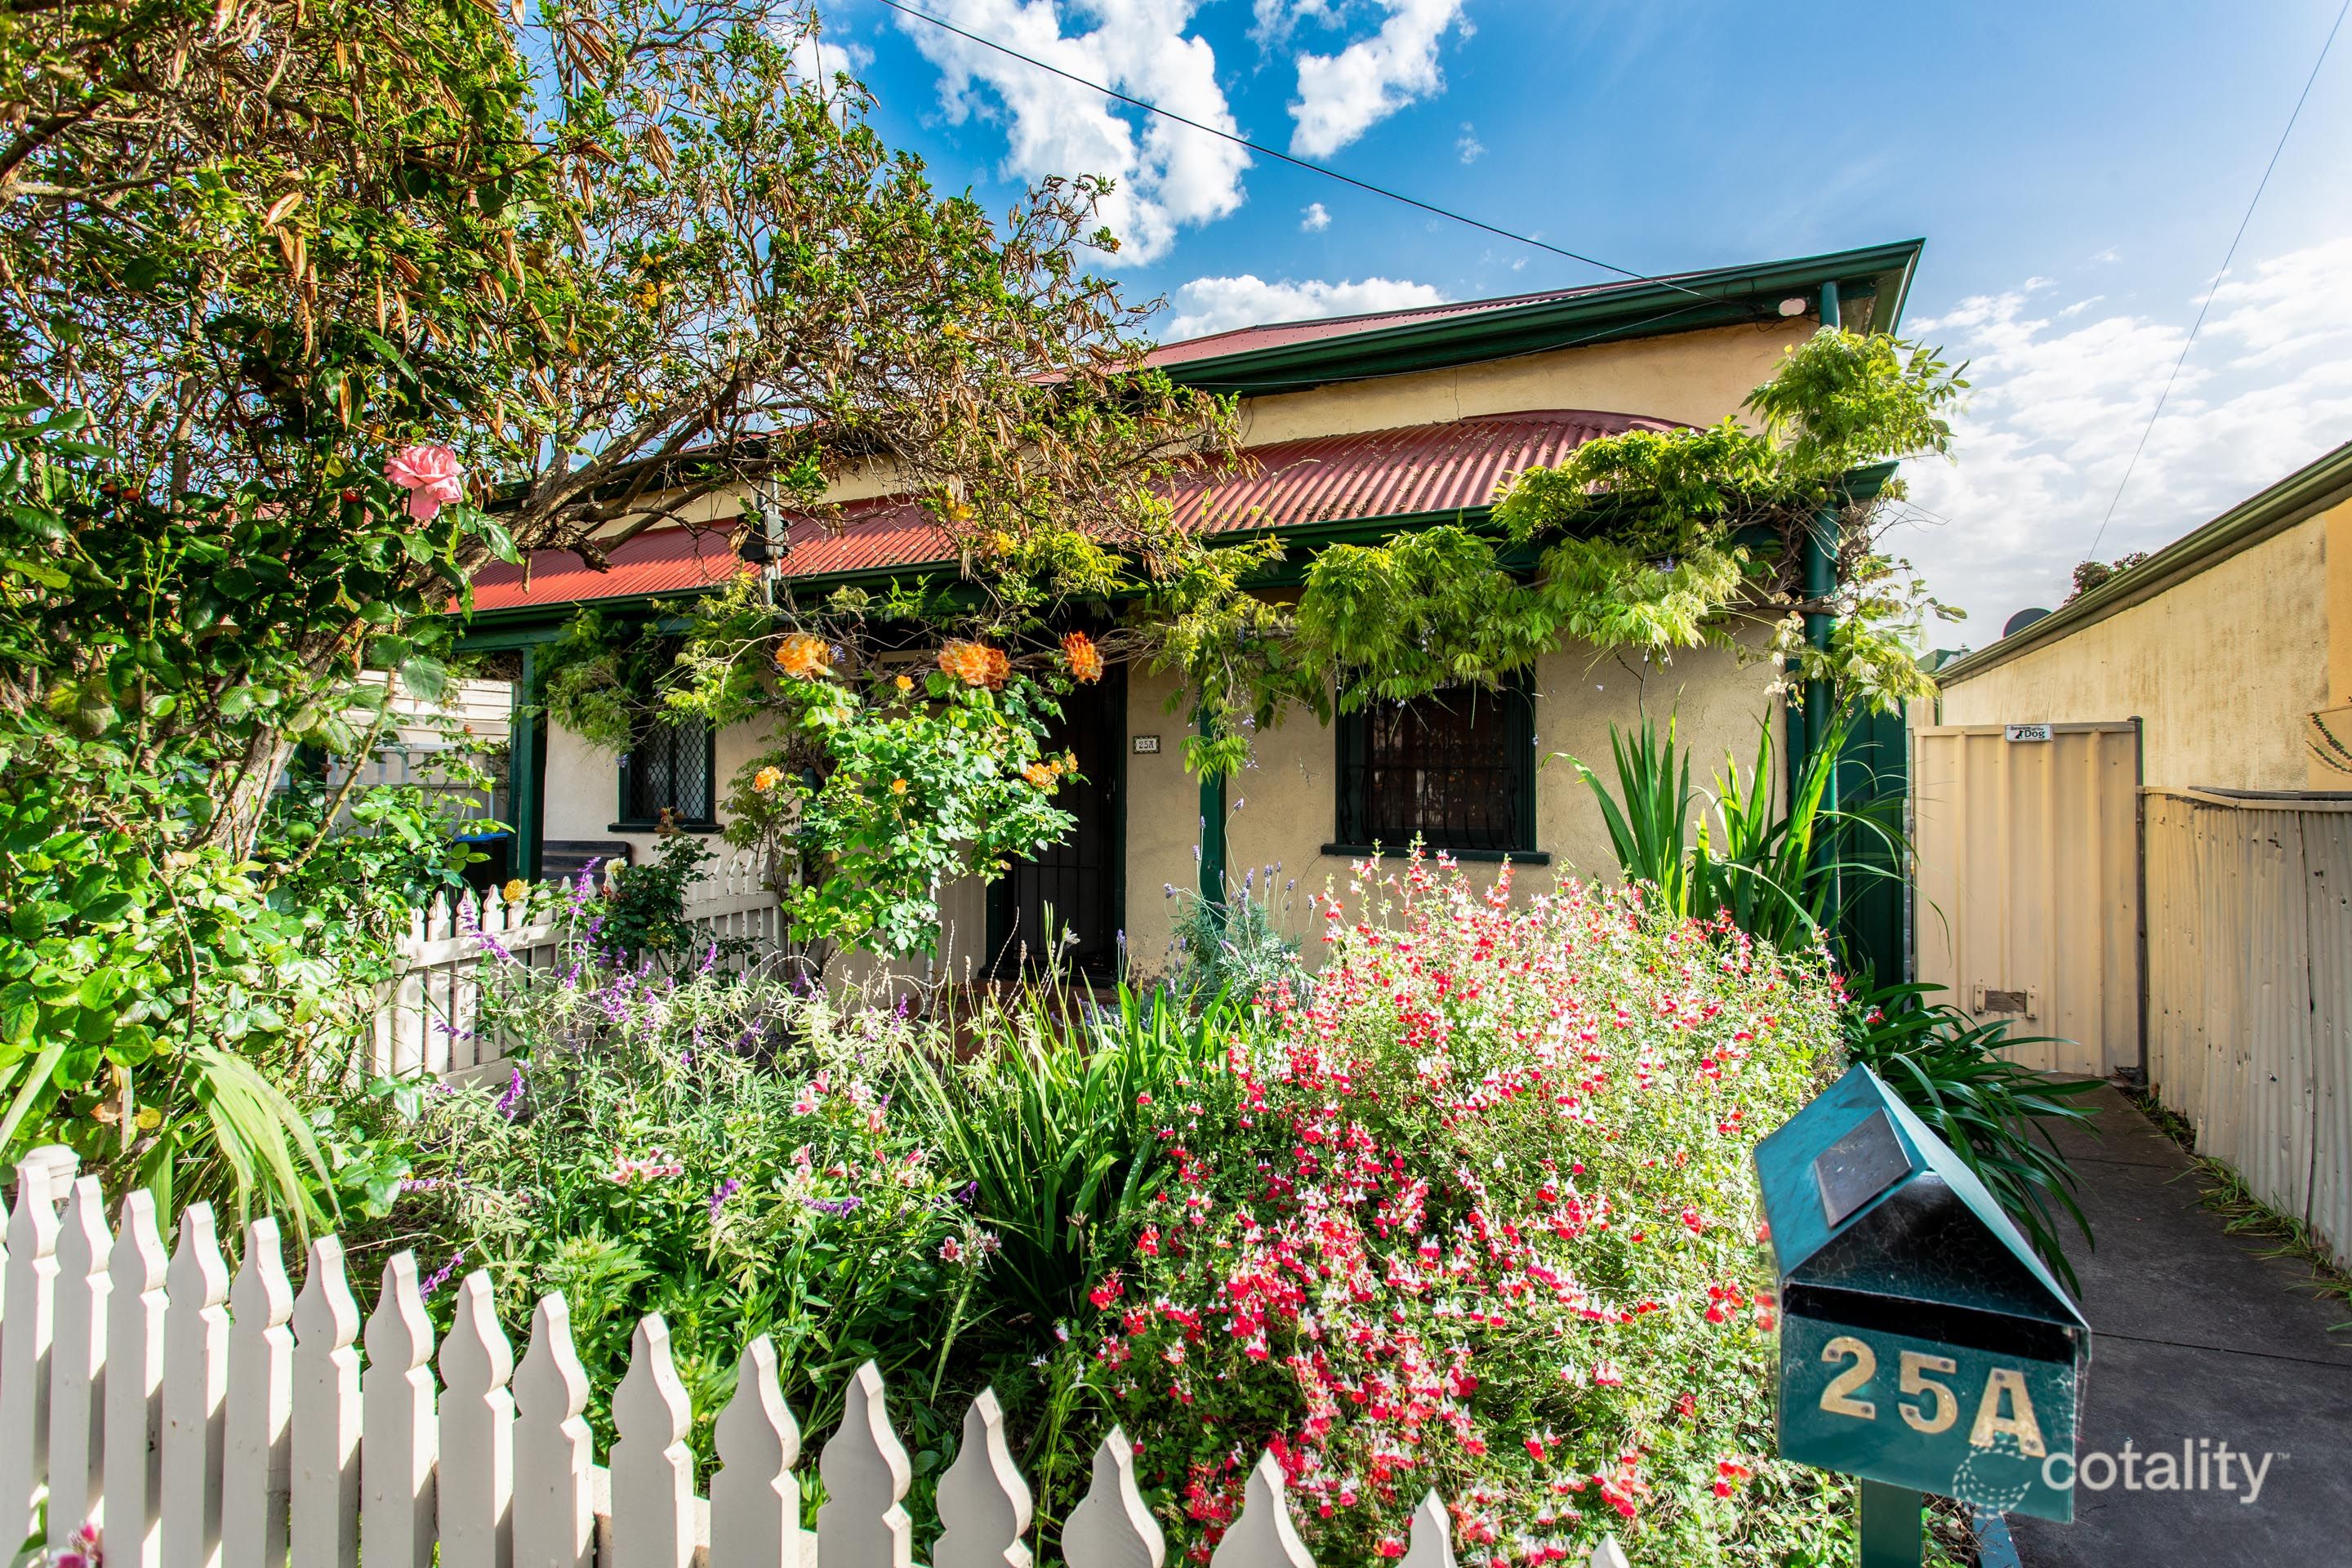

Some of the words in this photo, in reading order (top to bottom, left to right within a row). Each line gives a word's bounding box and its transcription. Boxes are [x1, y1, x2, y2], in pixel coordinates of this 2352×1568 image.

[2025, 730, 2045, 739] Dog
[1138, 740, 1154, 749] 25A
[1820, 1336, 2047, 1458] 25A
